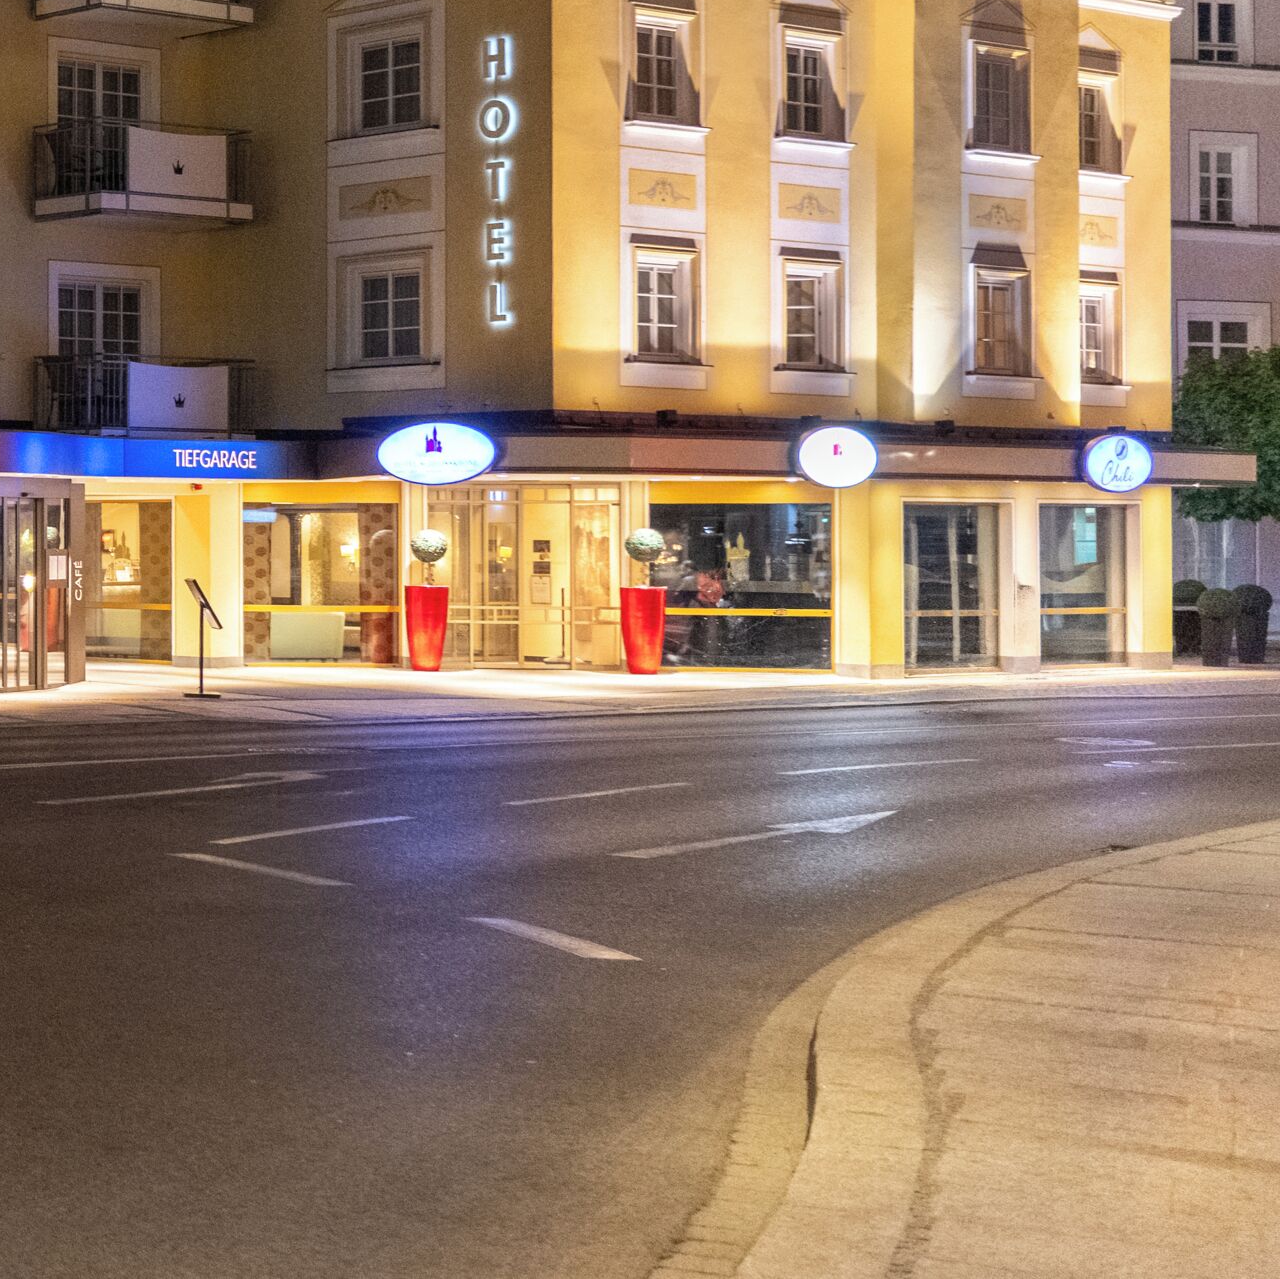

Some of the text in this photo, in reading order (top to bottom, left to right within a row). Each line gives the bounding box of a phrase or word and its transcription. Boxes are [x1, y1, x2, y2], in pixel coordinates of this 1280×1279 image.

[478, 37, 512, 324] HOTEL
[172, 449, 257, 469] TIEFGARAGE
[1101, 460, 1134, 486] Chili
[72, 560, 83, 601] CAFÉ
